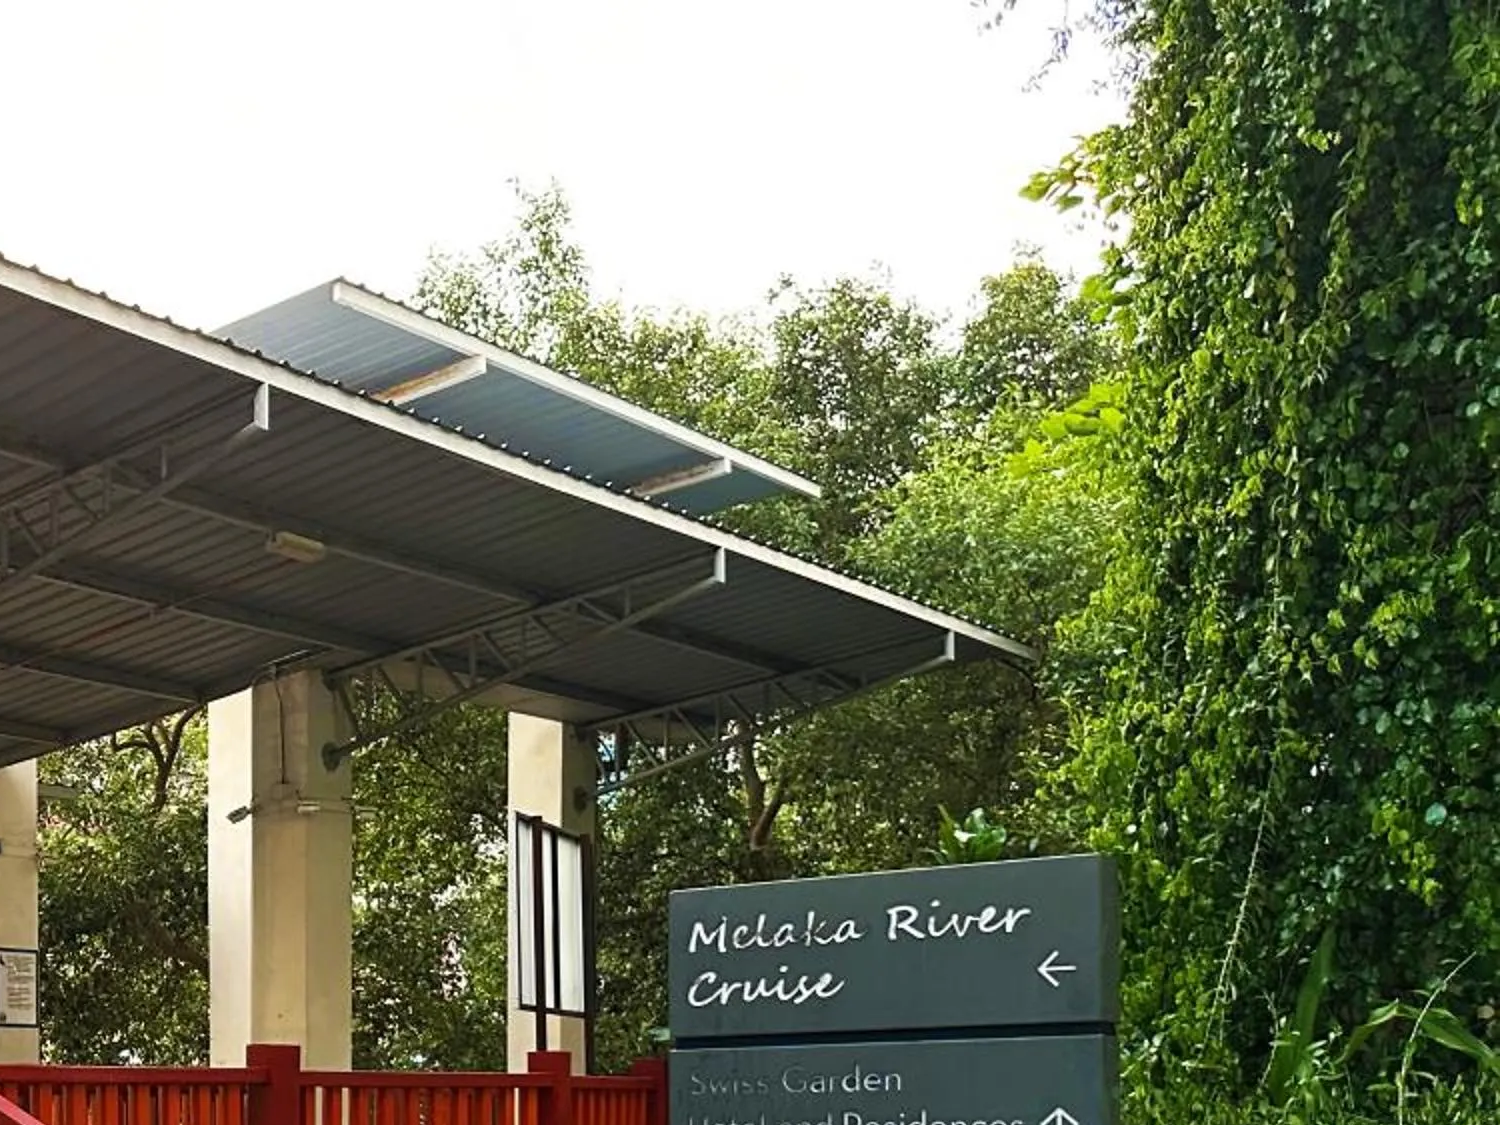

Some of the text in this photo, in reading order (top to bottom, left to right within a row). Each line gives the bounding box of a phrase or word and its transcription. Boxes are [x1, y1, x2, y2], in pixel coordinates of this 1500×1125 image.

[688, 899, 1032, 953] Melaka River
[687, 965, 845, 1007] Cruise
[690, 1063, 902, 1096] Swiss Garden
